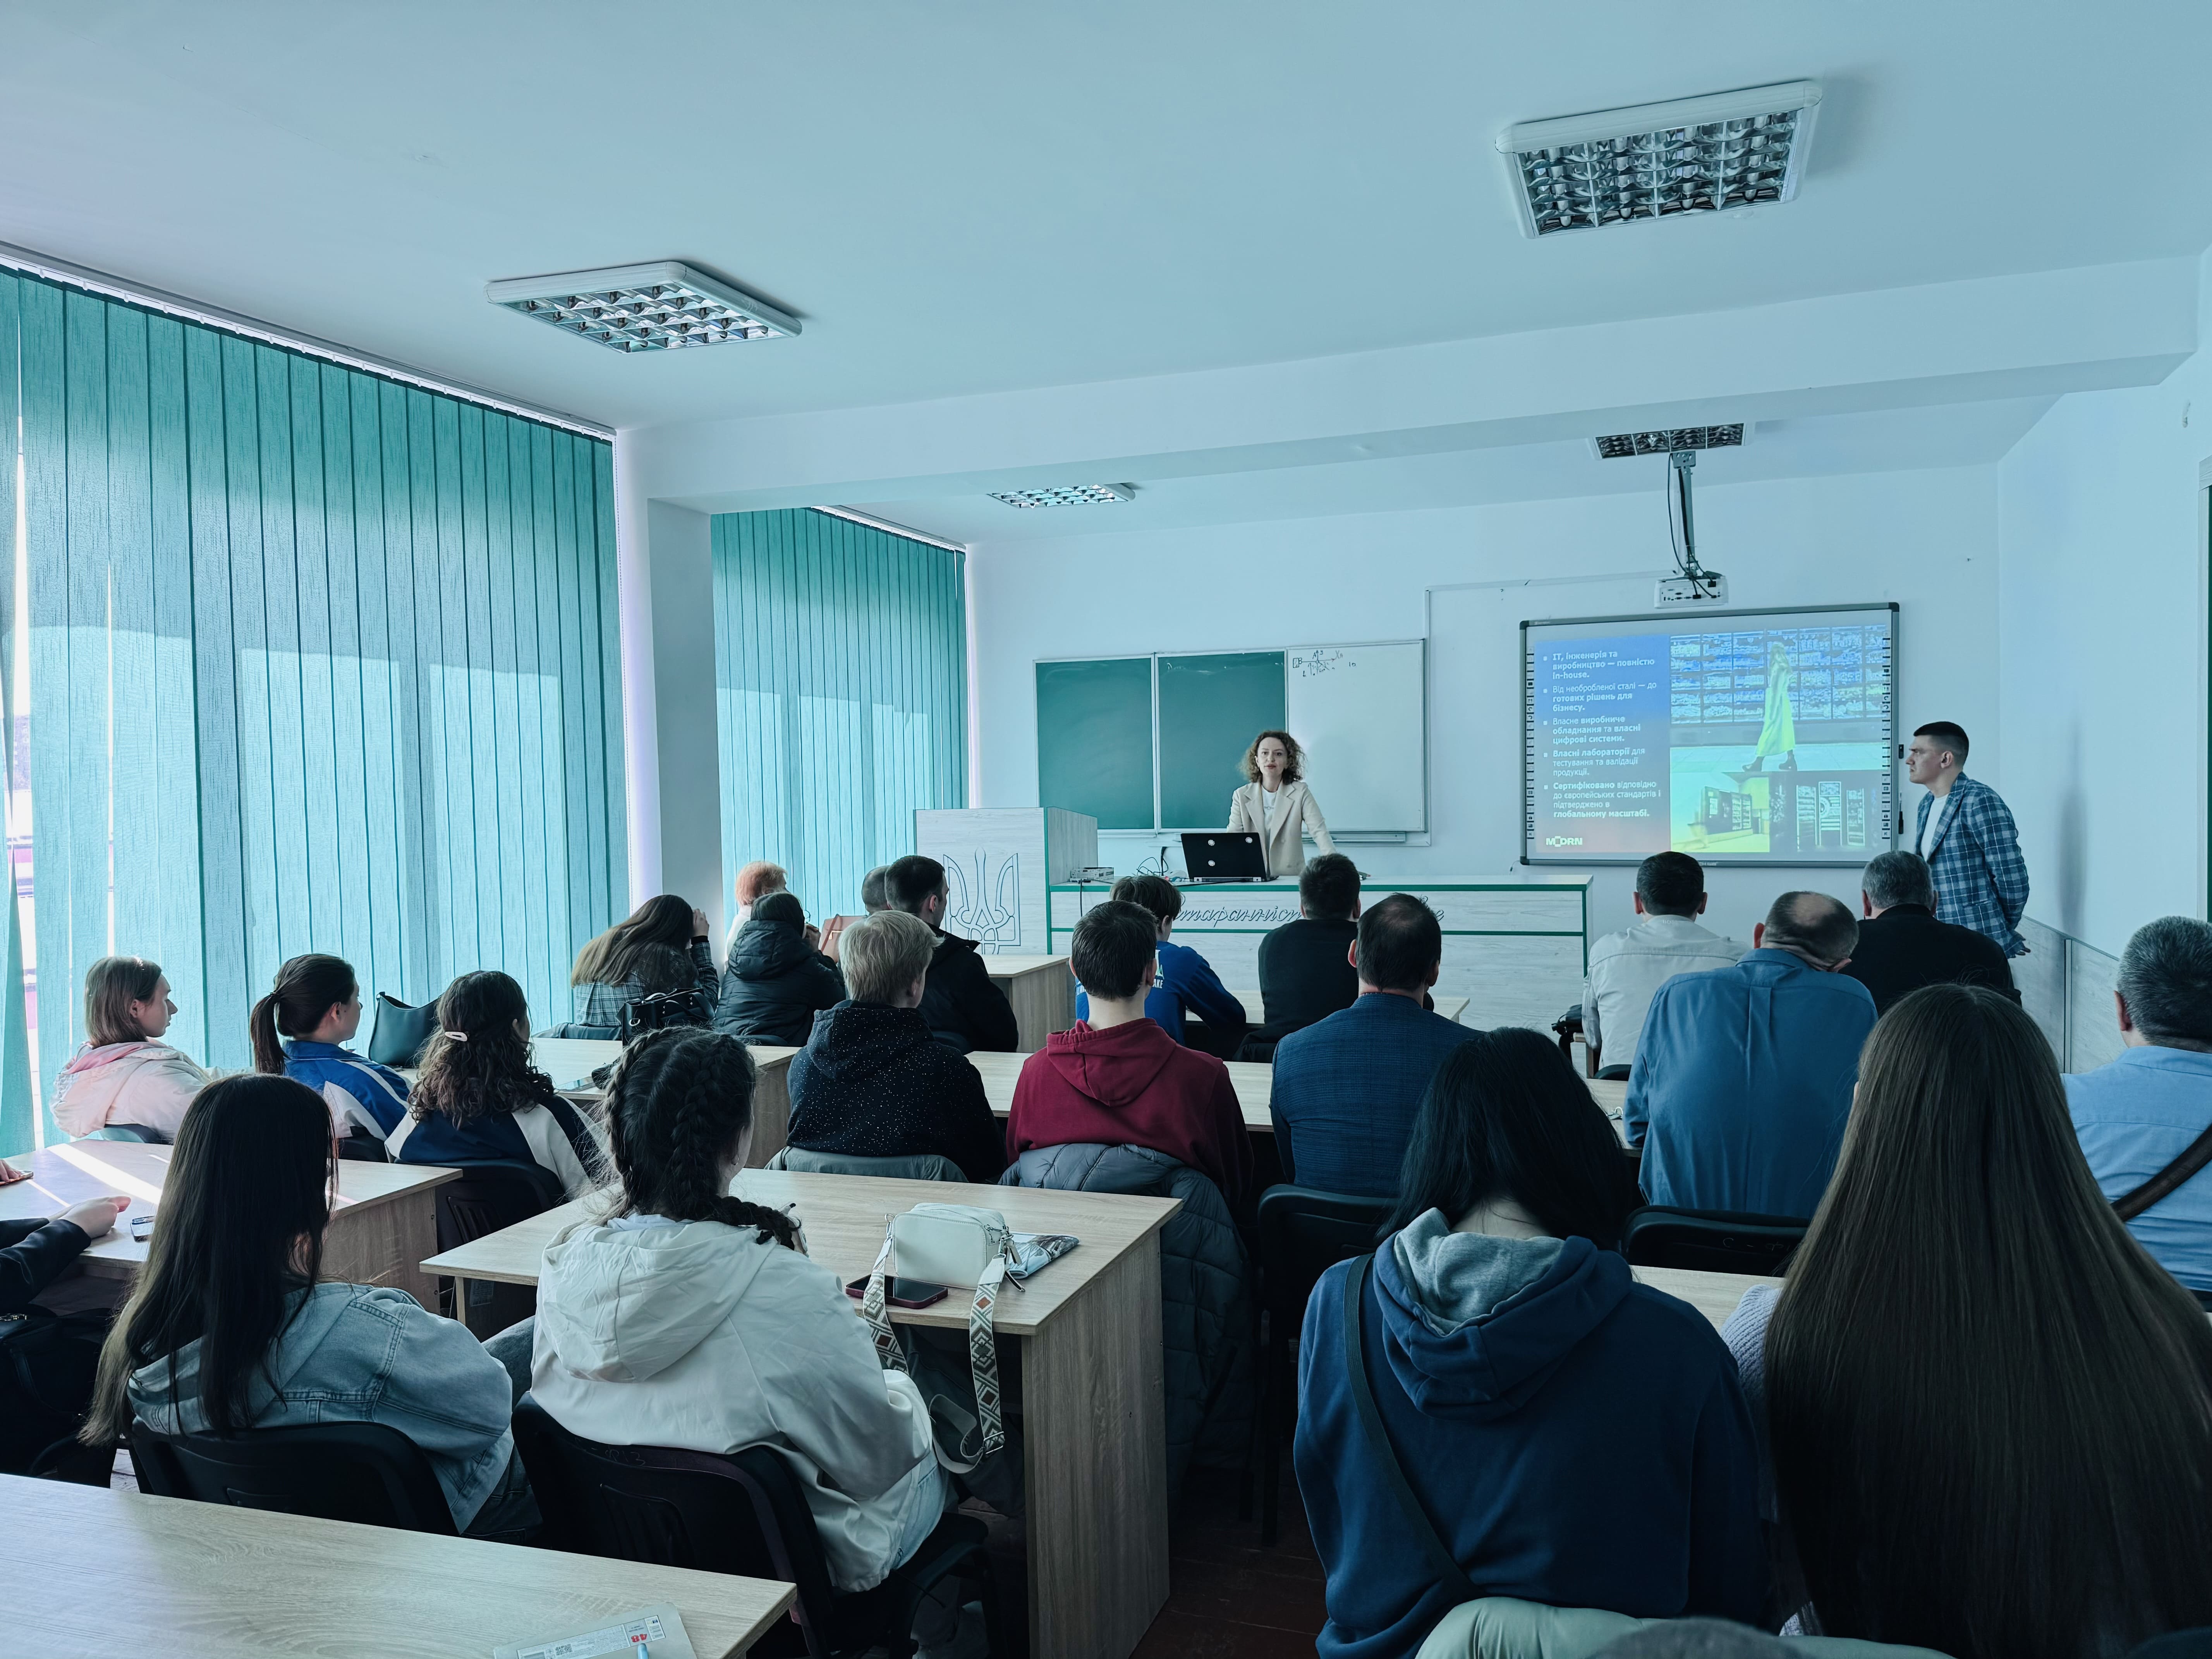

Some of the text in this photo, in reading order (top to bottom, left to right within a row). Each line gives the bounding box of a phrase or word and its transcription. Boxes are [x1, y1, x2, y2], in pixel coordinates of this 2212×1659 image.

[1566, 651, 1606, 660] інженерія
[1553, 661, 1606, 671] виробництво
[1617, 658, 1654, 666] повністю
[1566, 684, 1615, 692] необробленої
[1587, 693, 1615, 702] рішень
[1581, 716, 1625, 725] виробниче
[1553, 726, 1601, 735] обладнання
[1614, 724, 1640, 732] власні
[1553, 735, 1586, 745] цифрові
[1553, 749, 1579, 757] Власні
[1582, 748, 1630, 757] лабораторії
[1606, 757, 1638, 765] валідації
[1553, 768, 1589, 777] продукції.
[1553, 781, 1656, 790] Сертифіковано відповідно
[1564, 791, 1614, 799] європейських
[1617, 790, 1656, 799] стандартів
[1609, 809, 1650, 817] масштабі.
[1175, 905, 1301, 927] таранніст
[1152, 978, 1163, 989] AKE
